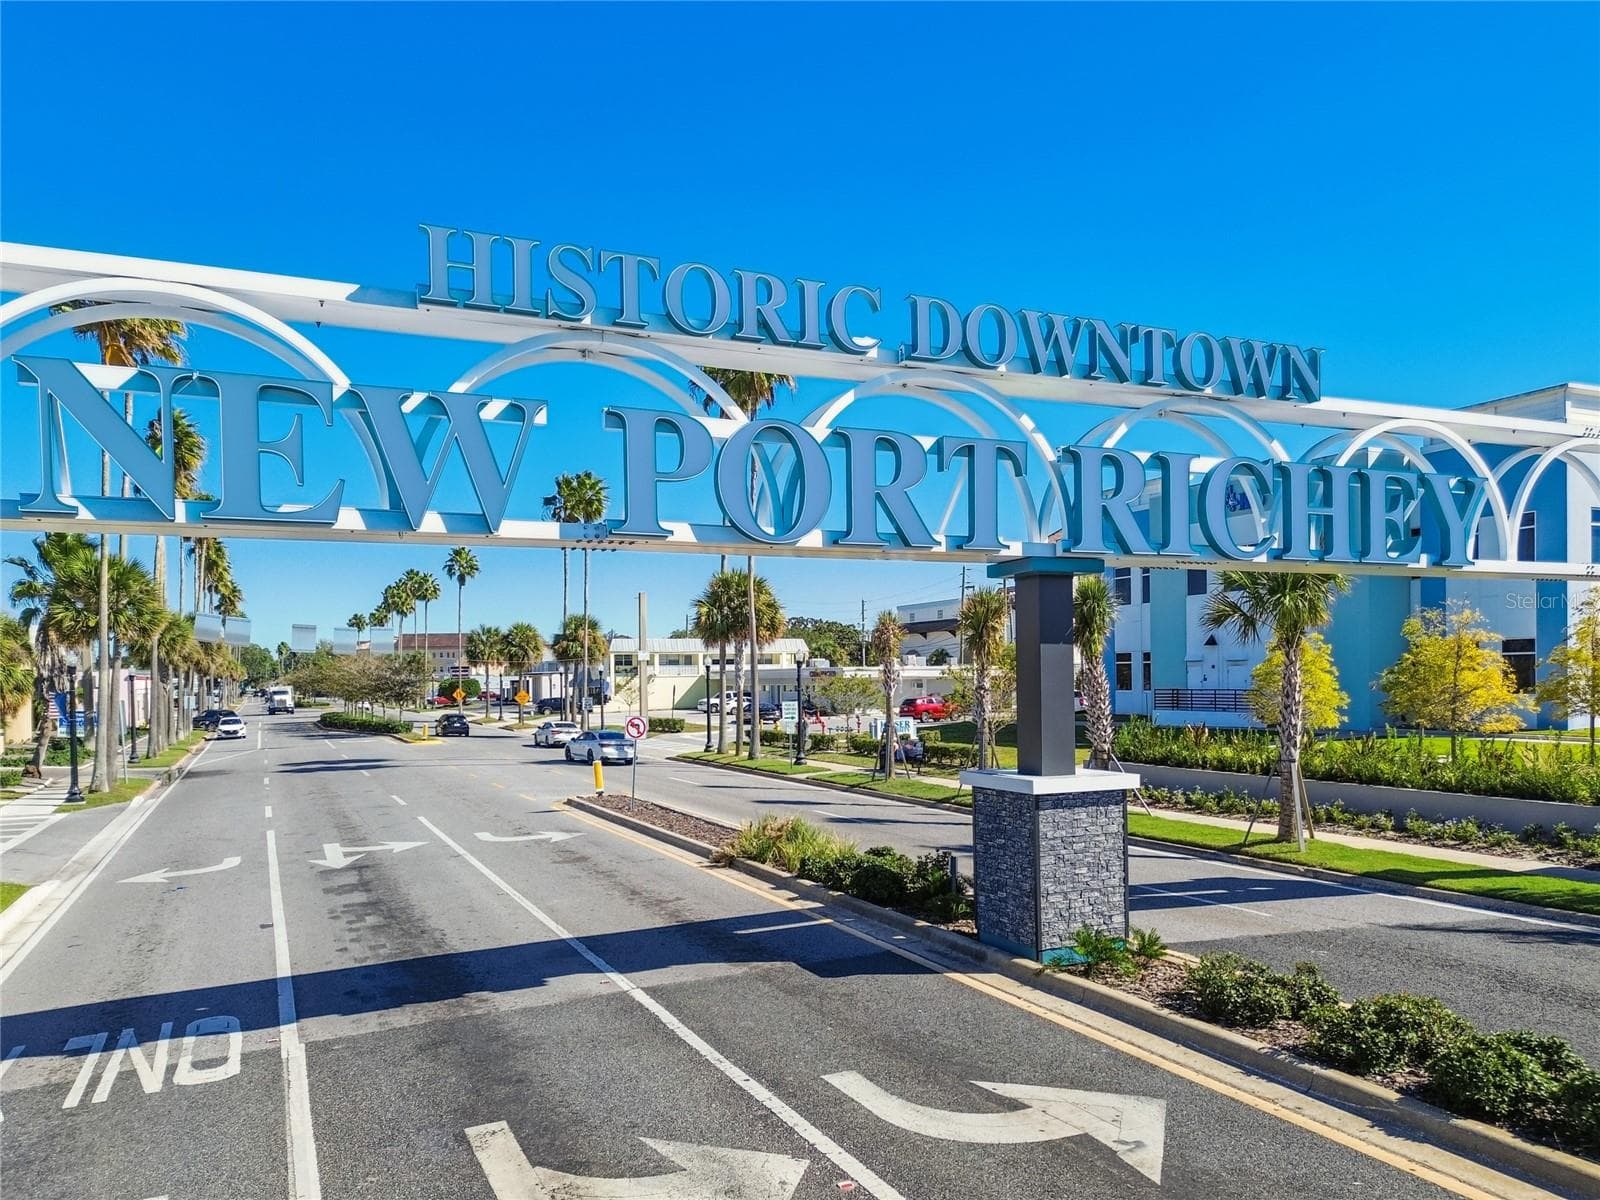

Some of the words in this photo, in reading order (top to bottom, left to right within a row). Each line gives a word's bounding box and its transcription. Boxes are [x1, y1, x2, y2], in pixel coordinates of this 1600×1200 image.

[418, 224, 882, 355] HISTORIC
[905, 293, 1326, 402] DOWNTOWN
[11, 355, 548, 534] NEW
[603, 406, 1028, 551] PORT
[1057, 445, 1488, 567] RICHEY
